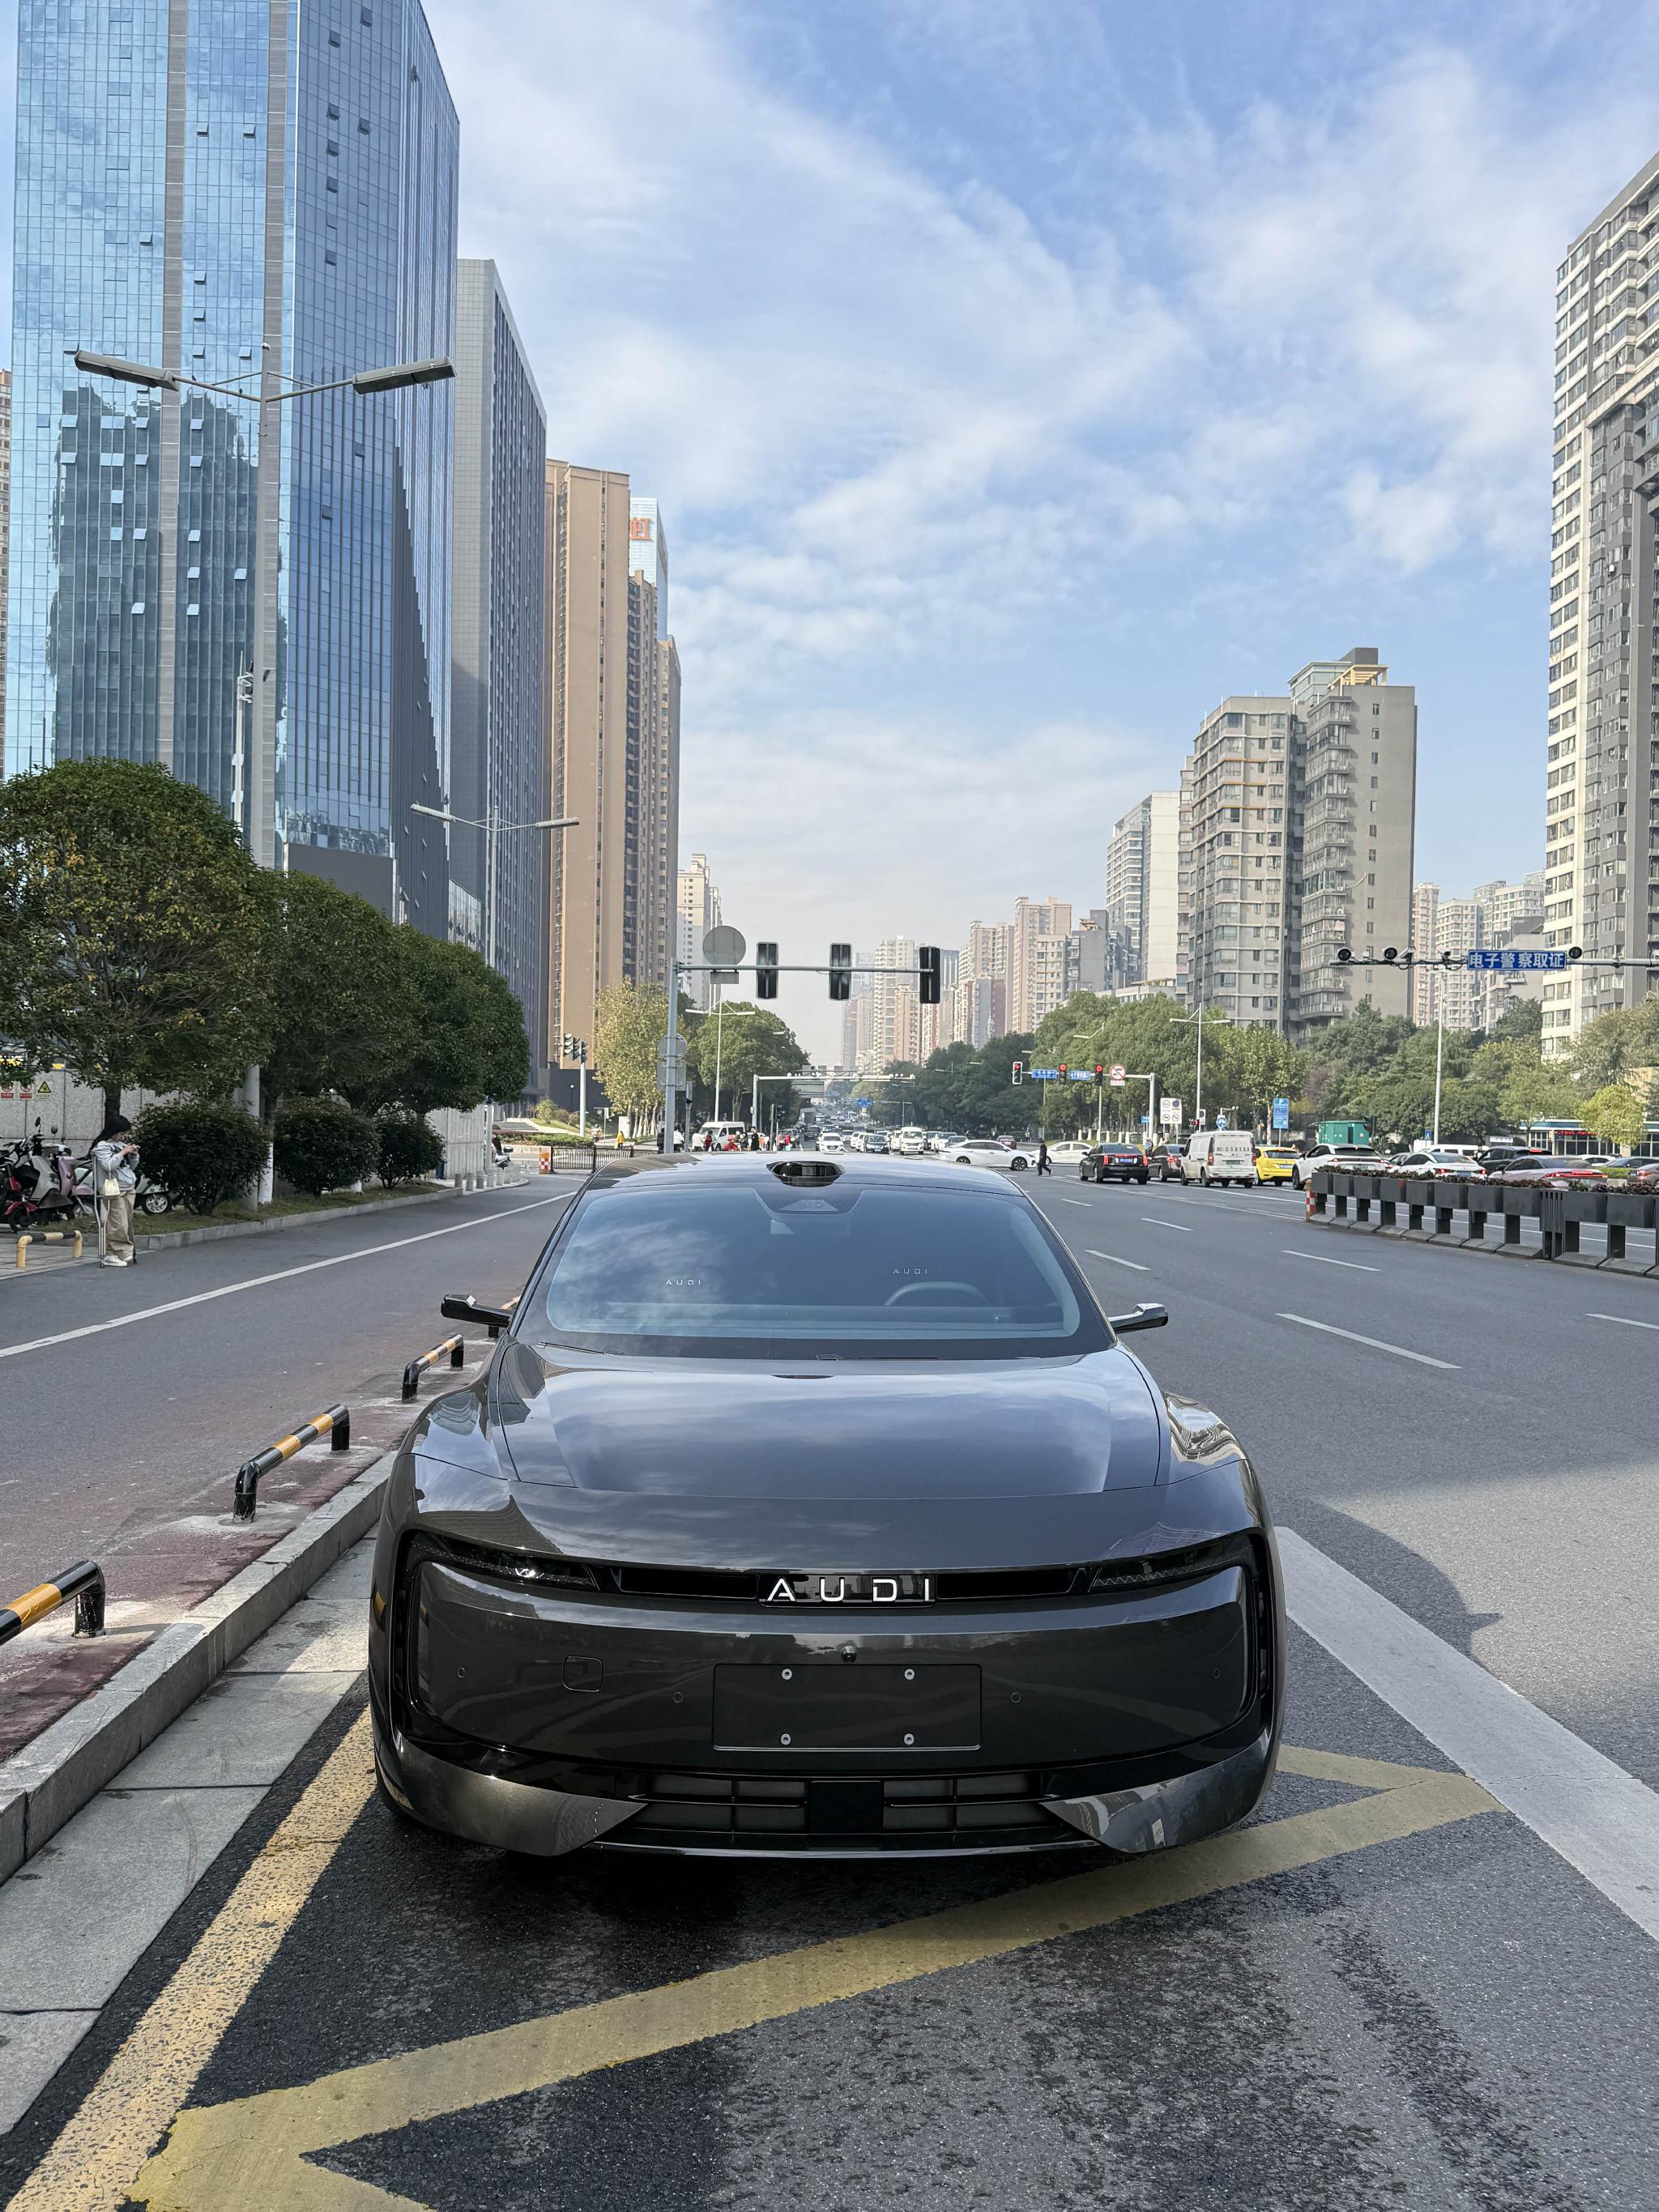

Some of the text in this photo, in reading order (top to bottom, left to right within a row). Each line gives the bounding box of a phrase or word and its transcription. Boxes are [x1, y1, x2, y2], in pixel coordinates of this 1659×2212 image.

[1470, 953, 1564, 968] 电子警察取证
[767, 1578, 929, 1602] AUDI
